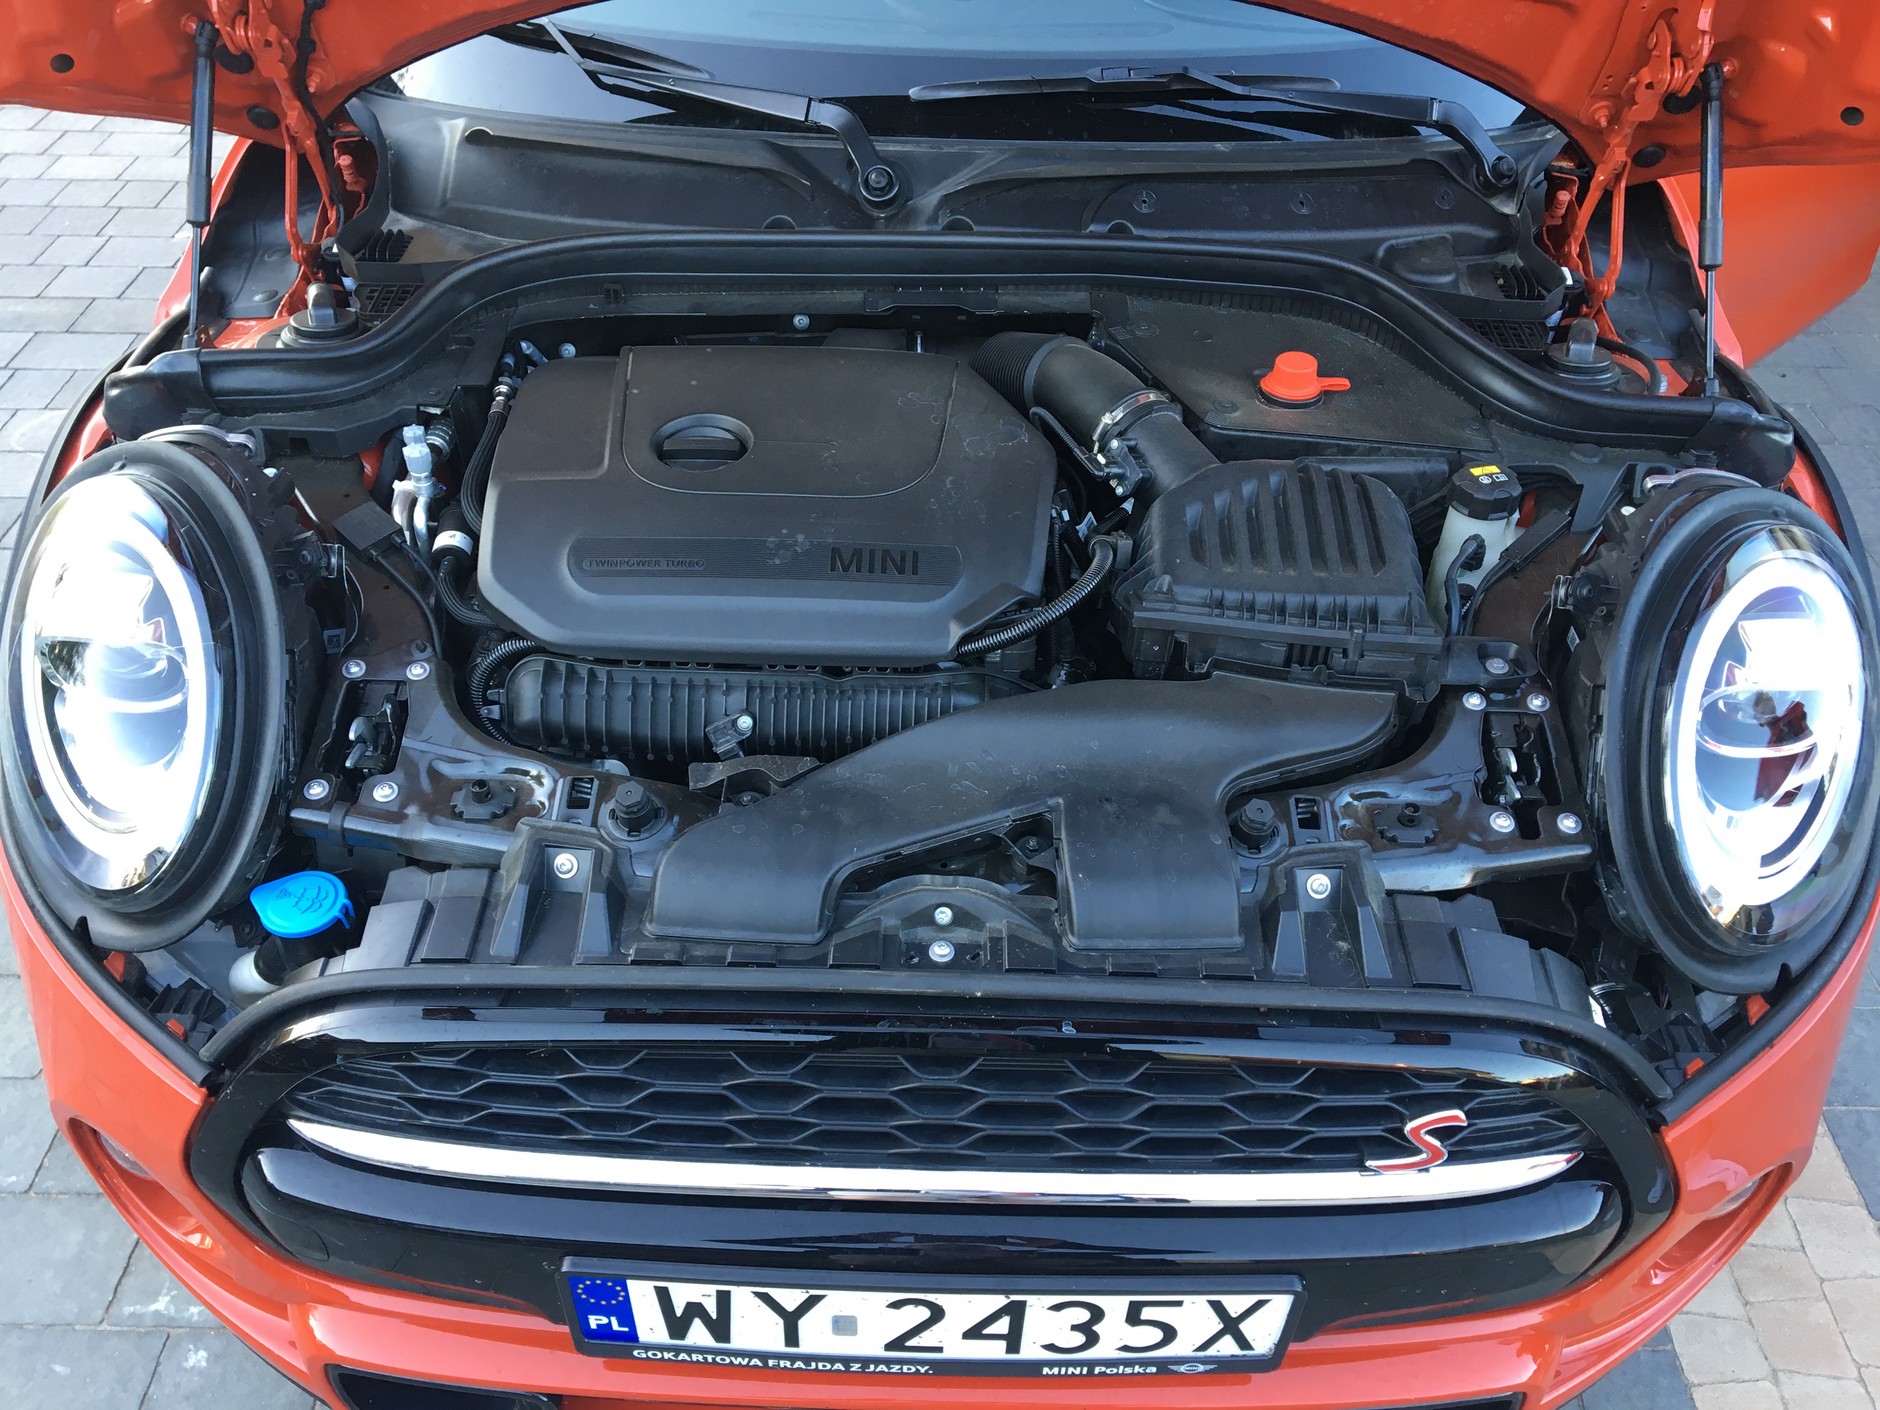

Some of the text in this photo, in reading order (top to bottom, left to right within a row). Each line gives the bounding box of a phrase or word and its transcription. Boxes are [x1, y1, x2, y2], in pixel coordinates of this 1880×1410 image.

[588, 559, 705, 568] TWINPOWER TURBO
[829, 546, 919, 576] MINI
[1365, 1109, 1468, 1175] S
[587, 1314, 629, 1332] PL
[653, 1285, 1274, 1355] WY 2435X
[632, 1349, 934, 1374] GOKARTOWA FRAJDA Z JAZDY.
[1042, 1364, 1157, 1375] MINI Polska
